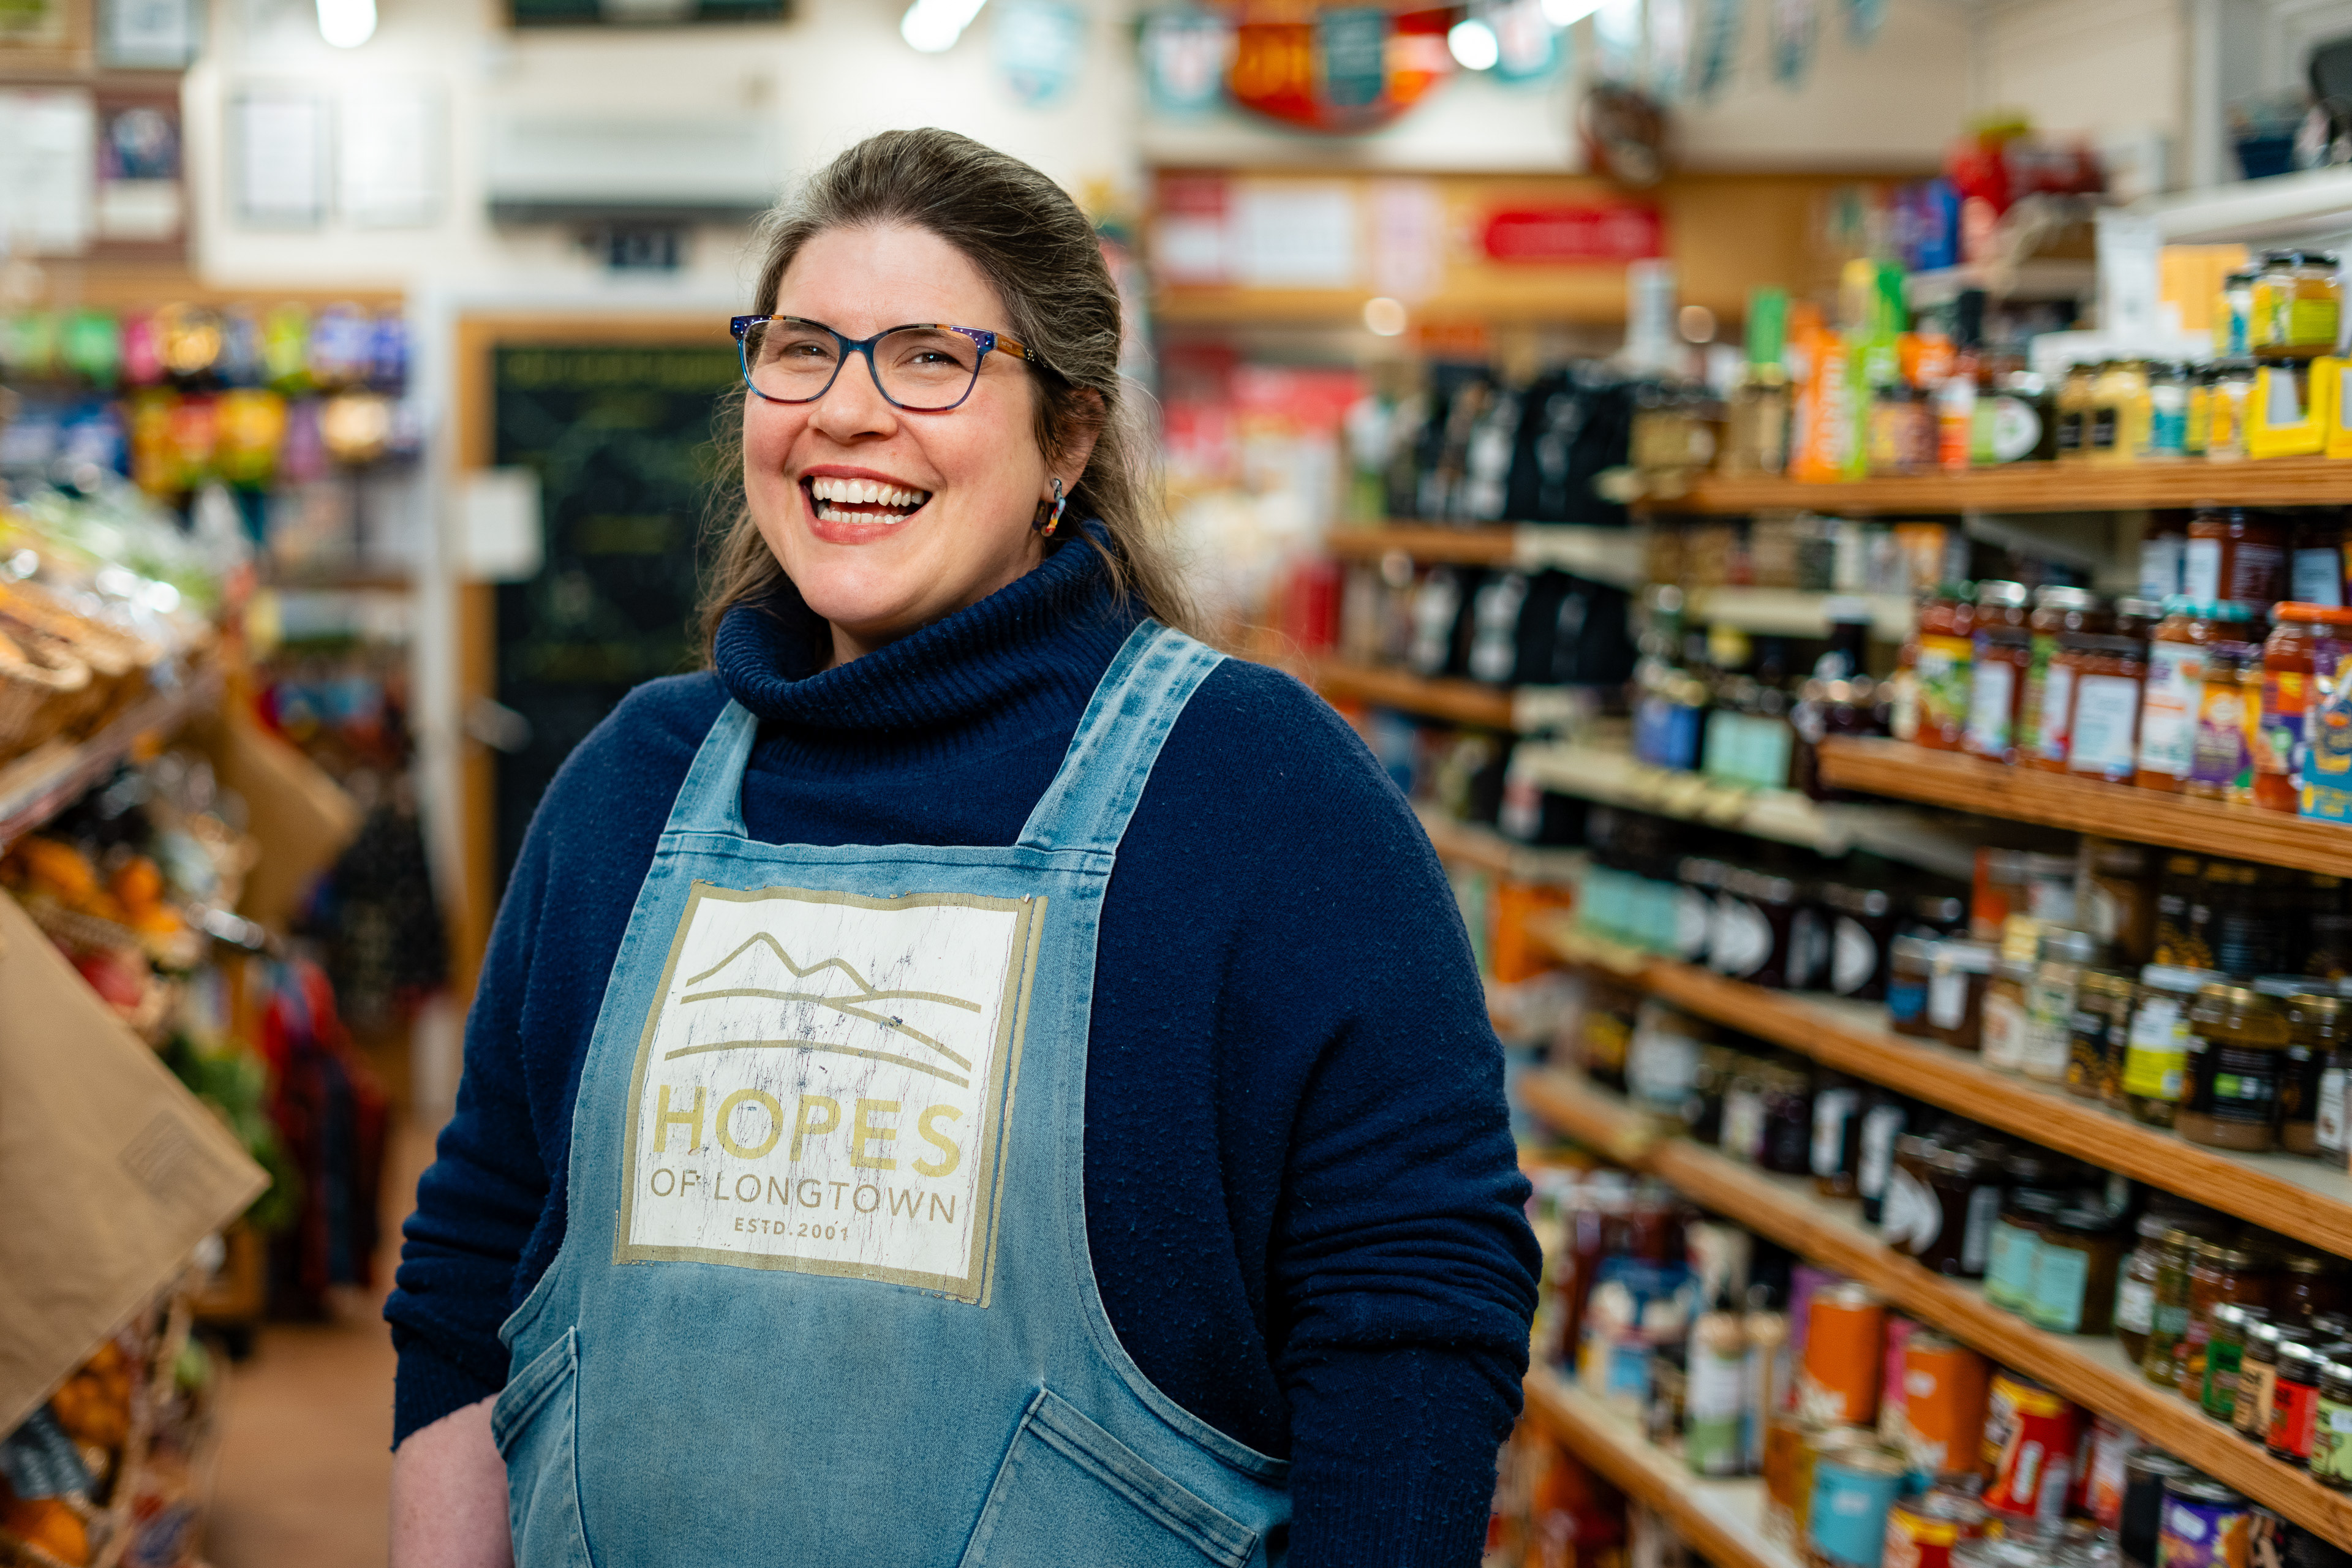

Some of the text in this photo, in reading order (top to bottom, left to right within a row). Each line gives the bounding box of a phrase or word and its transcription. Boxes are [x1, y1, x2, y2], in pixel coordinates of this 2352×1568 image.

[653, 1084, 963, 1177] HOPES
[650, 1167, 957, 1224] OF LONGTOWN
